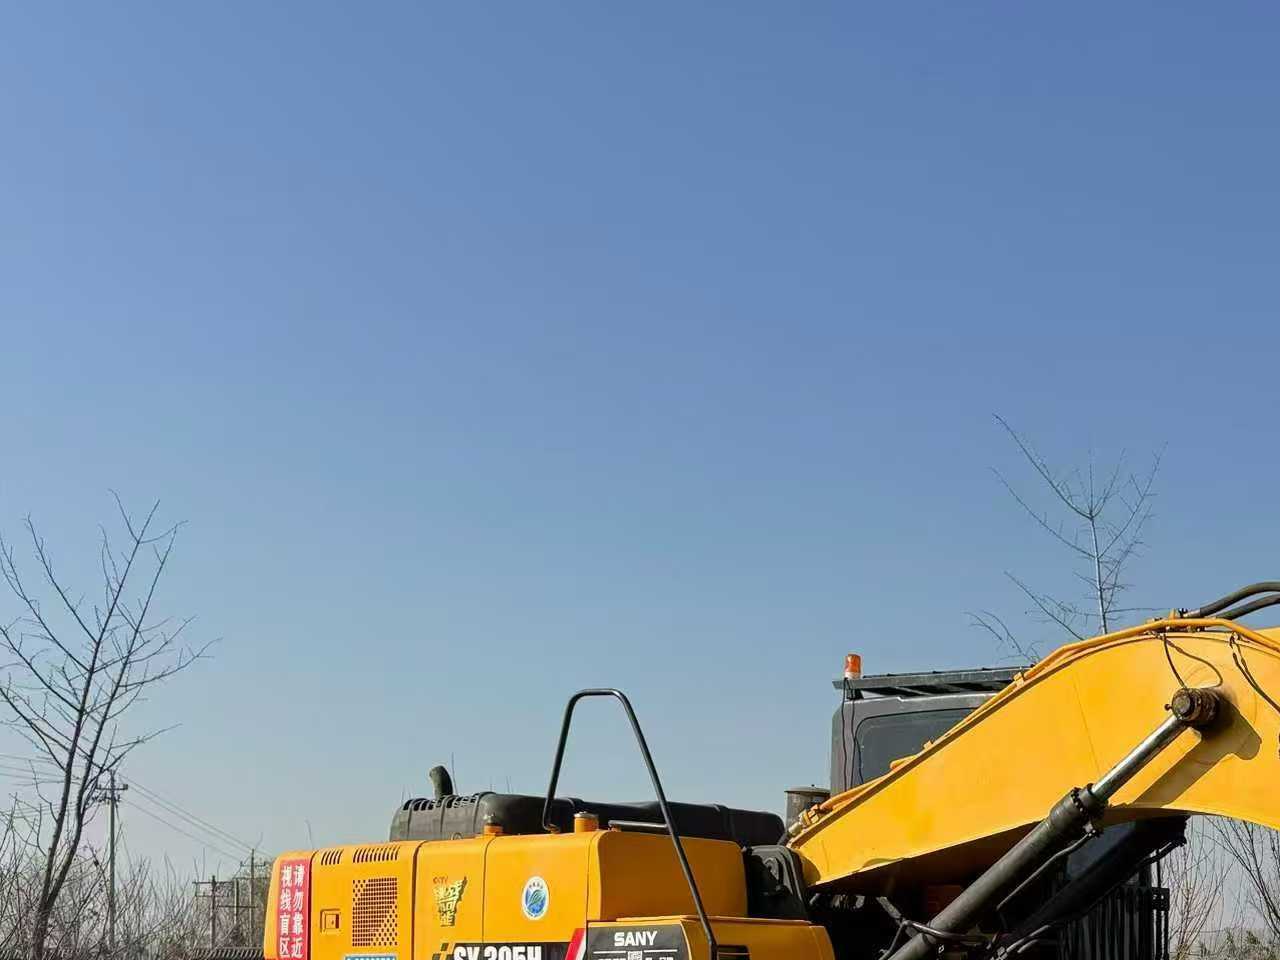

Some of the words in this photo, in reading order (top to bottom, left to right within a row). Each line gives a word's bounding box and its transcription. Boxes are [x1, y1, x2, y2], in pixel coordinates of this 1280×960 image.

[280, 864, 293, 959] 视线盲区
[291, 864, 305, 959] 请勿靠近
[614, 930, 658, 947] SANY
